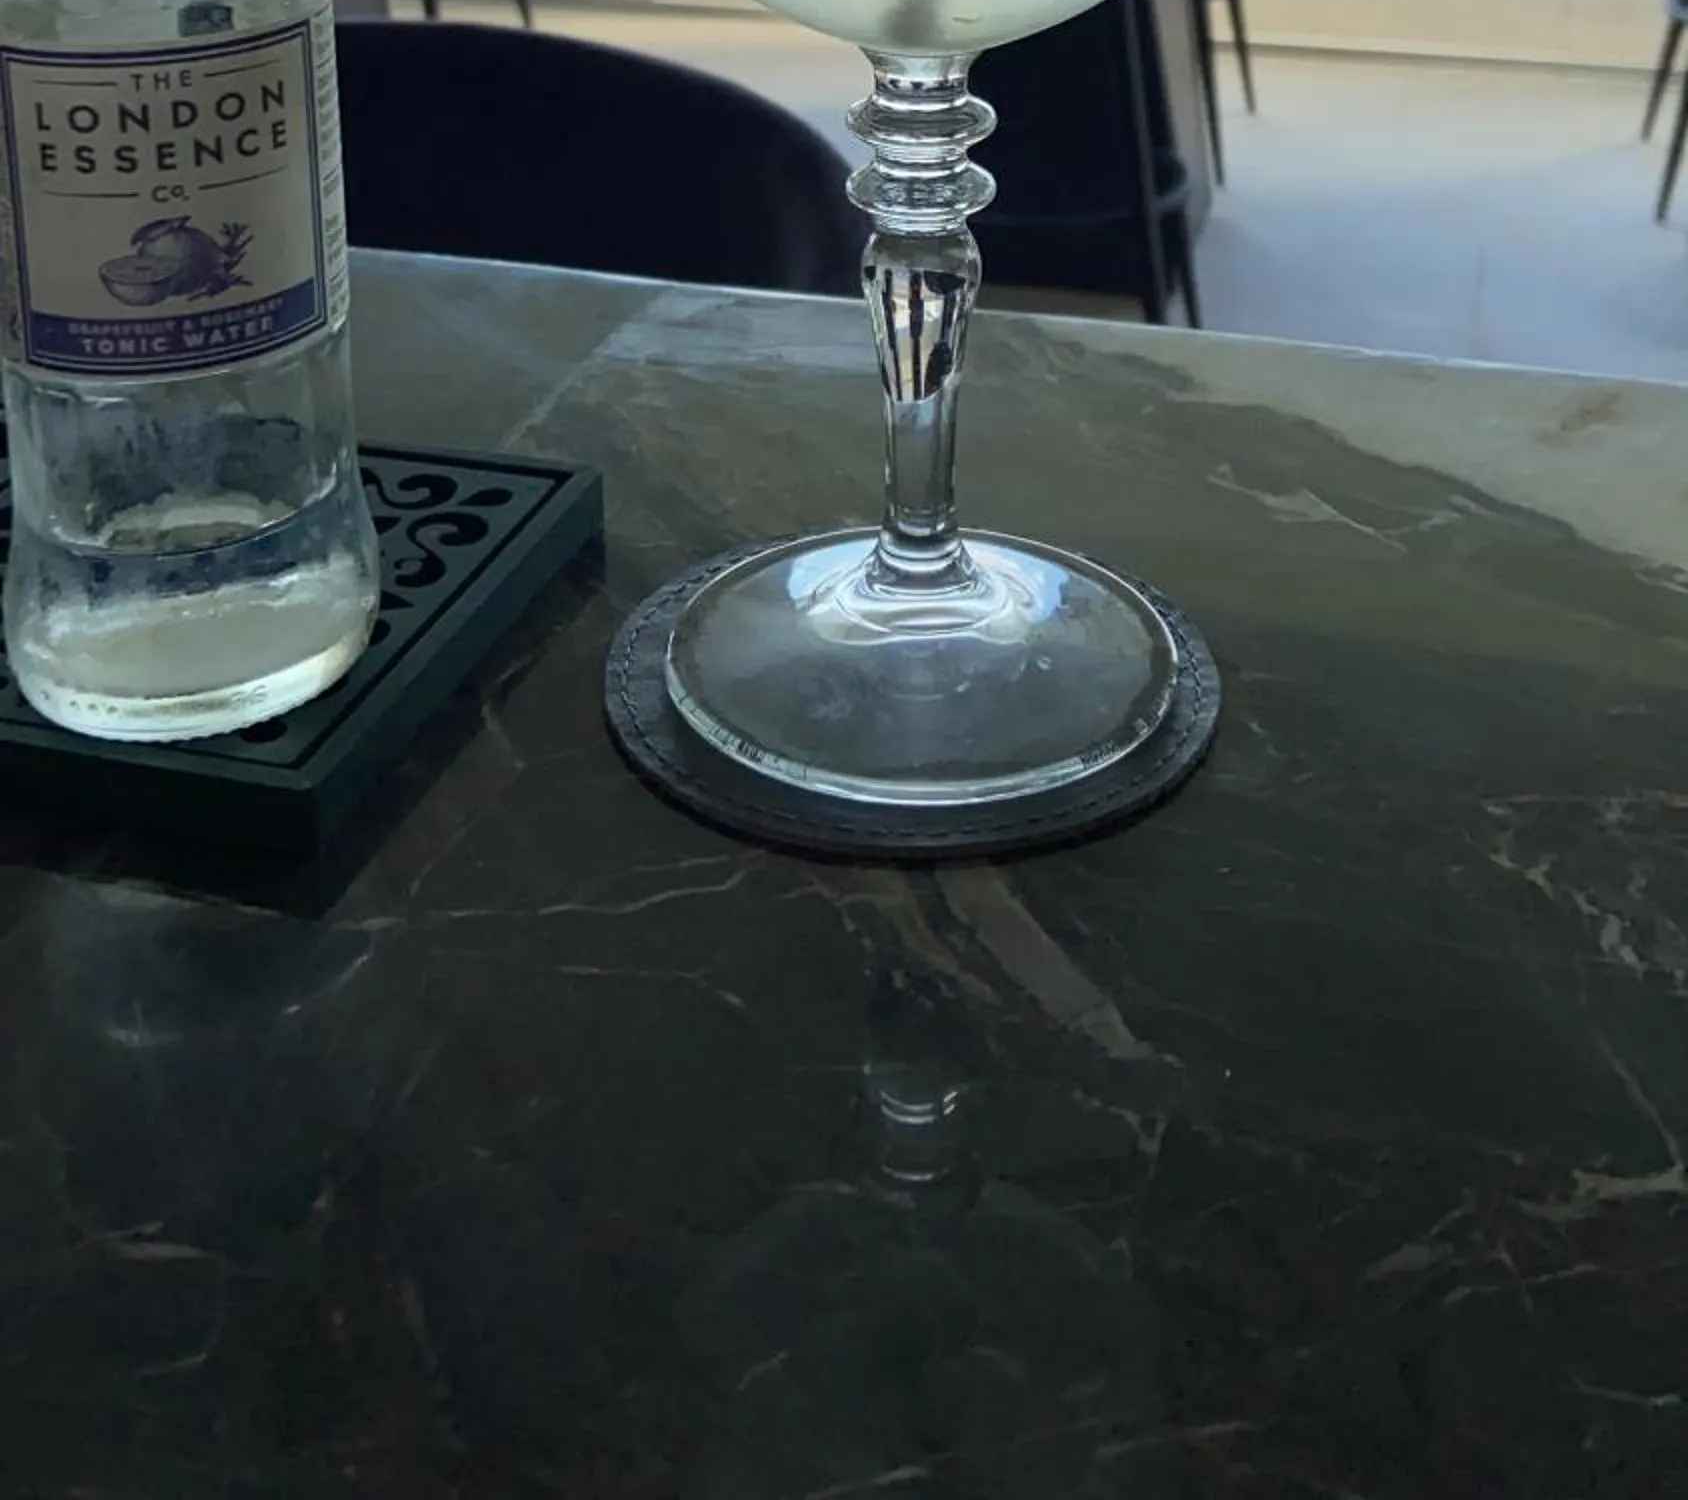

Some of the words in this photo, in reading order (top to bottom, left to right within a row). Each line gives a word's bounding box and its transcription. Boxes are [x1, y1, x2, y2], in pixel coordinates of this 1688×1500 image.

[130, 69, 194, 93] THE
[34, 79, 286, 134] LONDON
[40, 119, 288, 174] ESSENCE
[82, 337, 168, 355] TONIC
[182, 315, 274, 348] WATER
